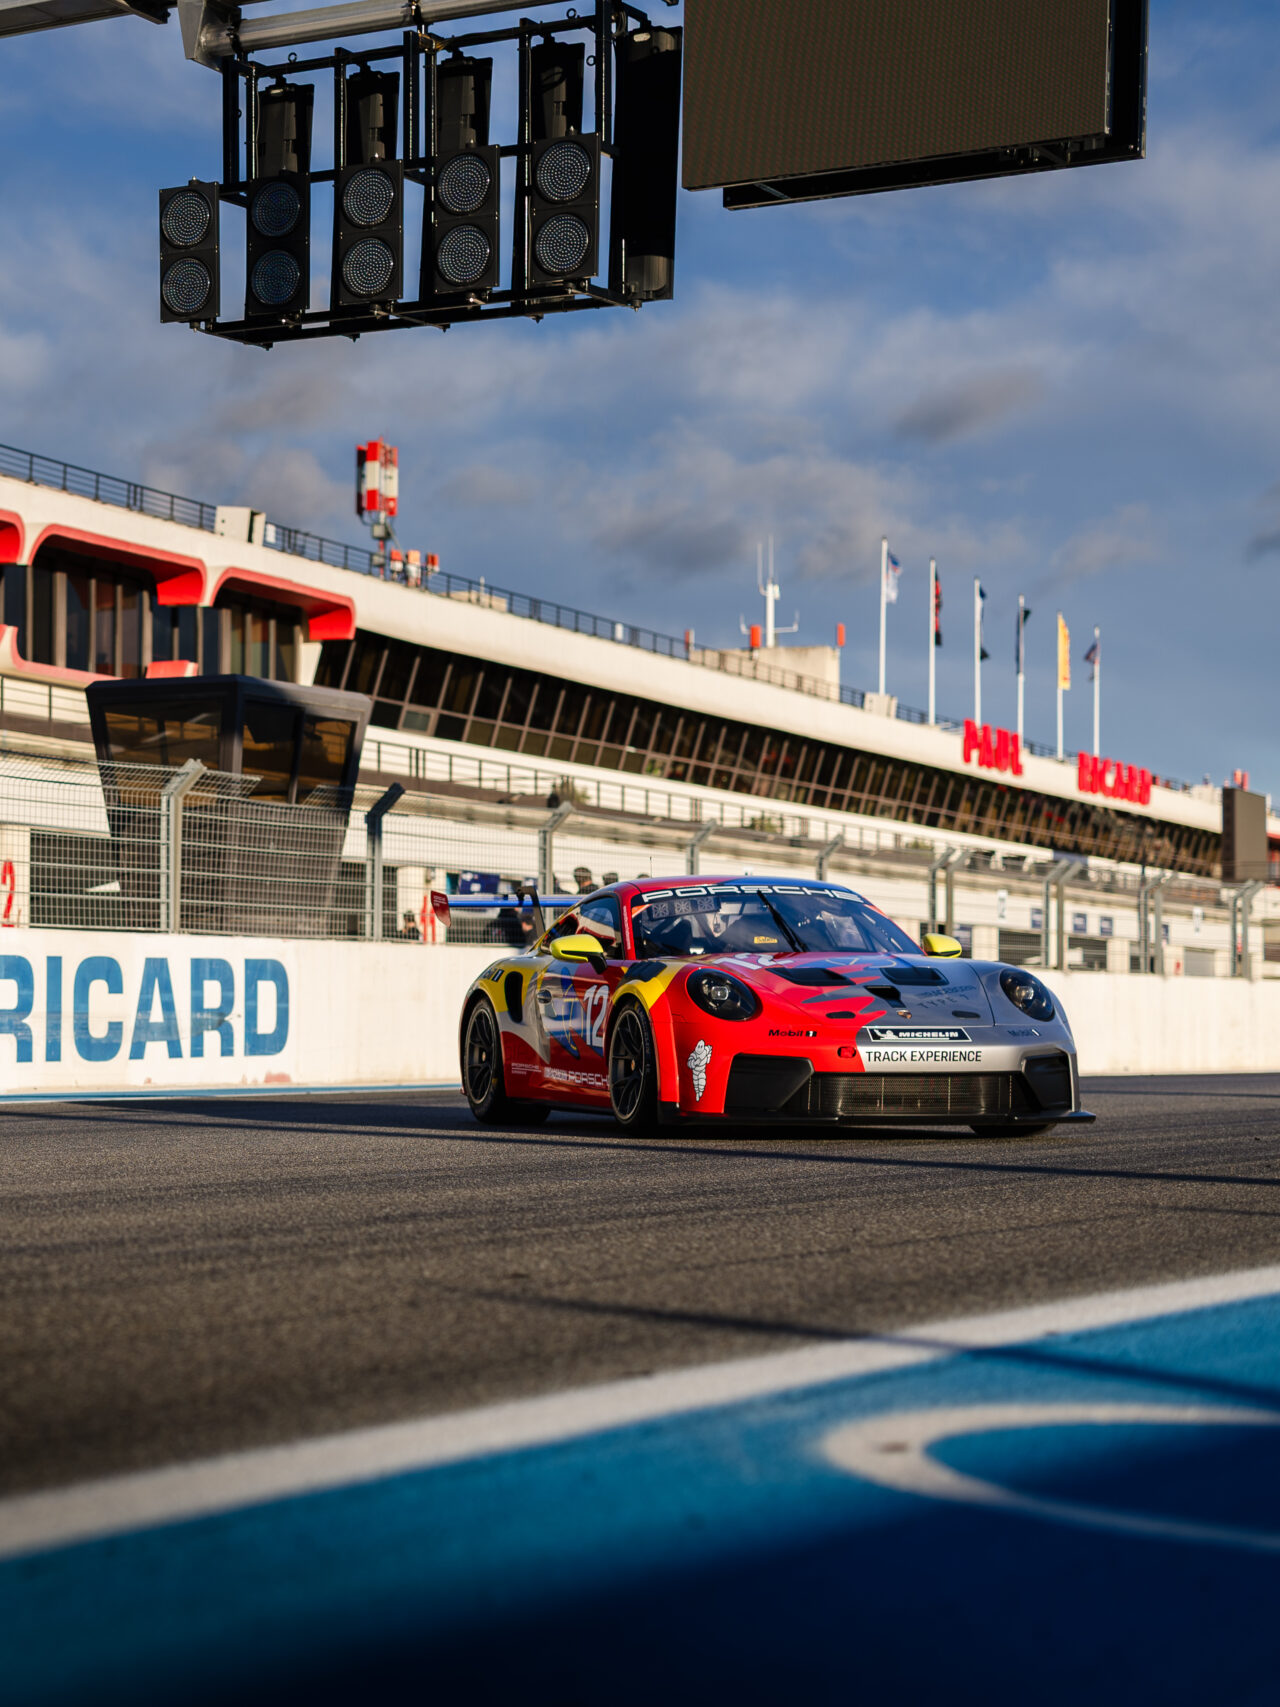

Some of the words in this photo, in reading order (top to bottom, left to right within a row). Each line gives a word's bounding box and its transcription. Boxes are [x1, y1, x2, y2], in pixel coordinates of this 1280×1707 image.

[641, 885, 865, 903] PORSCHE
[712, 953, 794, 970] 12
[583, 984, 609, 1047] 12
[898, 1030, 959, 1038] MICHELIN
[865, 1051, 908, 1062] TRACK
[910, 1050, 983, 1062] EXPERIENCE
